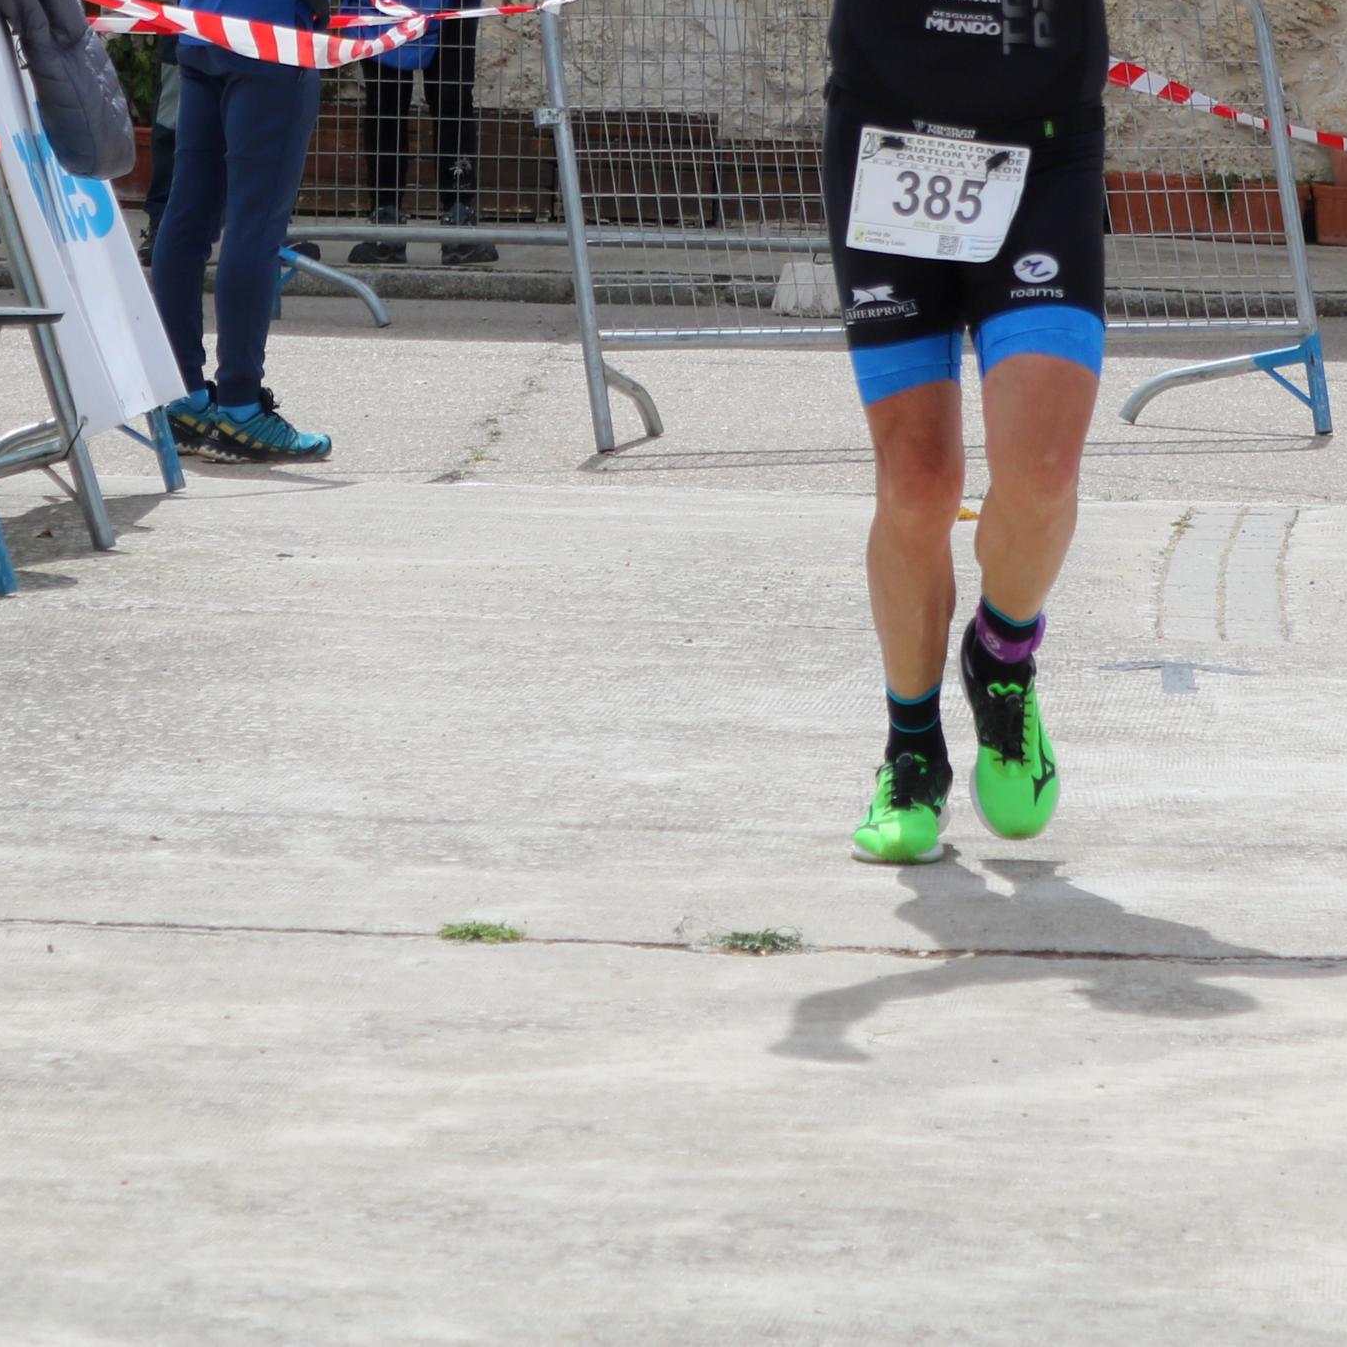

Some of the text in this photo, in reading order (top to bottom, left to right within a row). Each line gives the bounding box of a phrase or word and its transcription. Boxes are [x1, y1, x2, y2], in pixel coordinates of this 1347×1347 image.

[932, 10, 994, 21] DESGUACES
[925, 16, 1002, 36] MUNDO
[903, 145, 962, 160] RIATLON
[905, 137, 996, 156] EDERACION
[896, 153, 966, 170] CASTILLA
[892, 170, 986, 225] 385
[1010, 288, 1064, 299] roams
